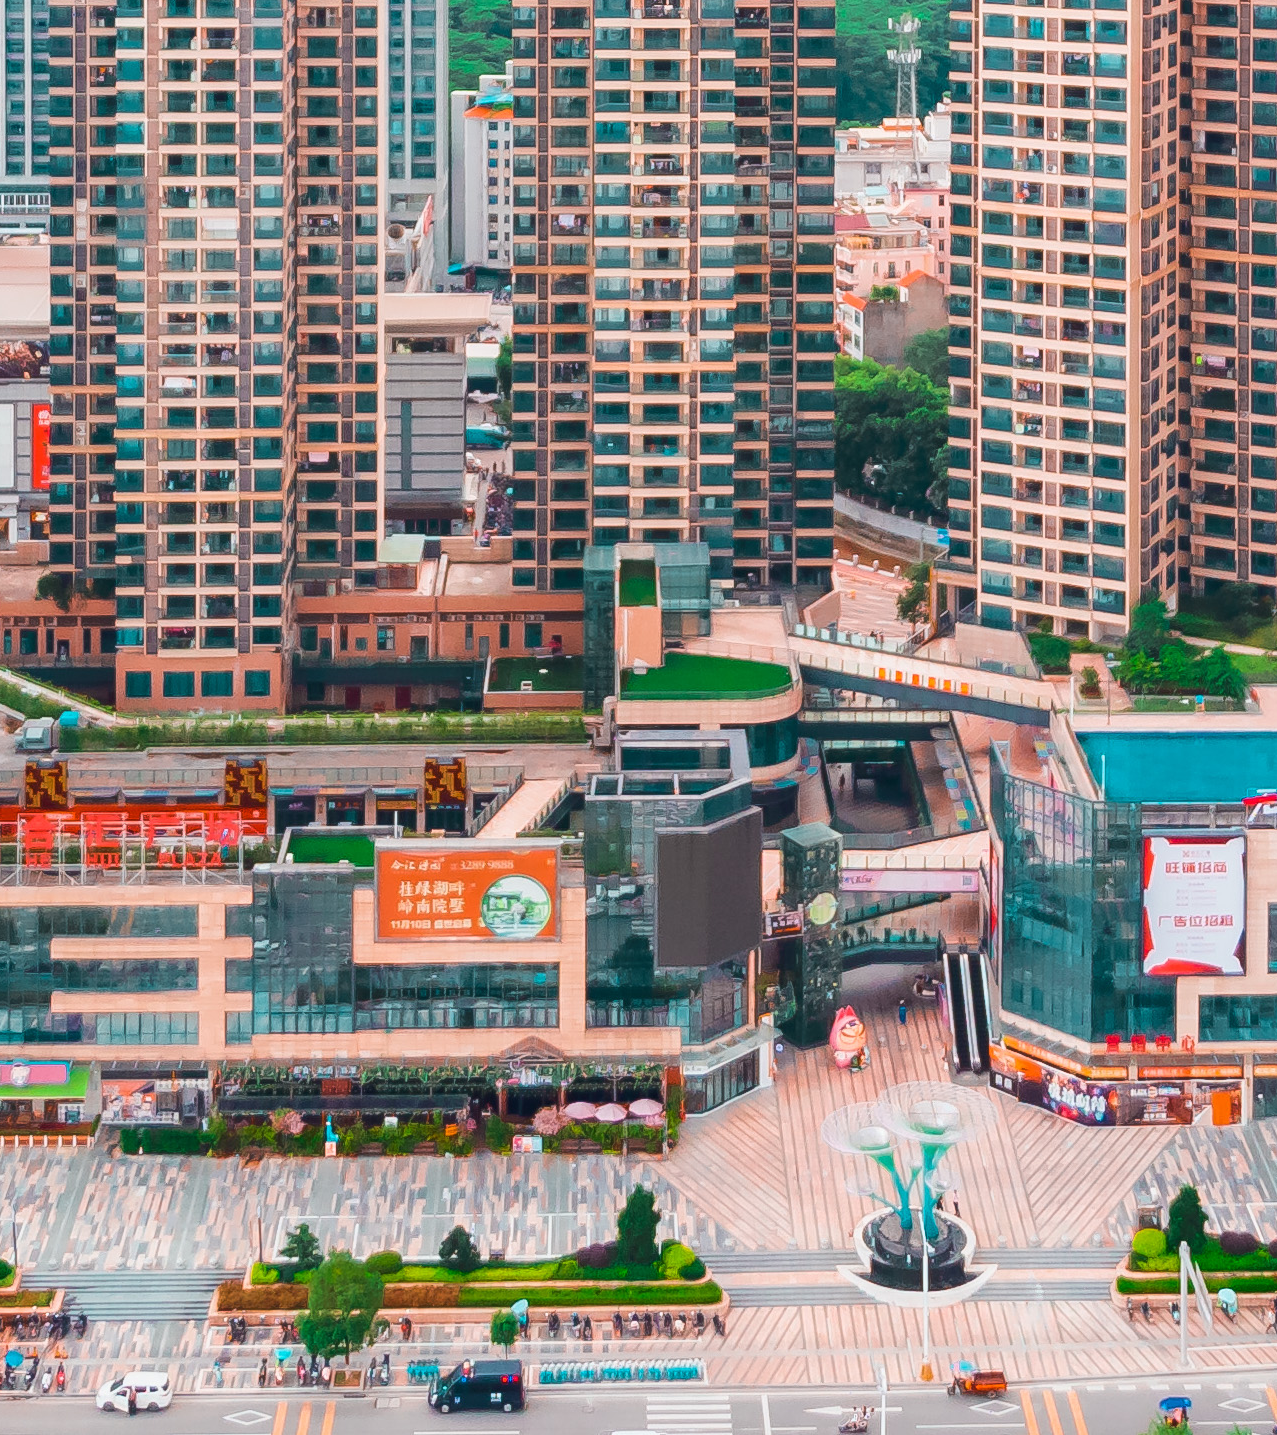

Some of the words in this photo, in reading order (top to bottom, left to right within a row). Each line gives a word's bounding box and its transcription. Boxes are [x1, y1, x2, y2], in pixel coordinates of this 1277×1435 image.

[1158, 914, 1234, 928] 广告位招租
